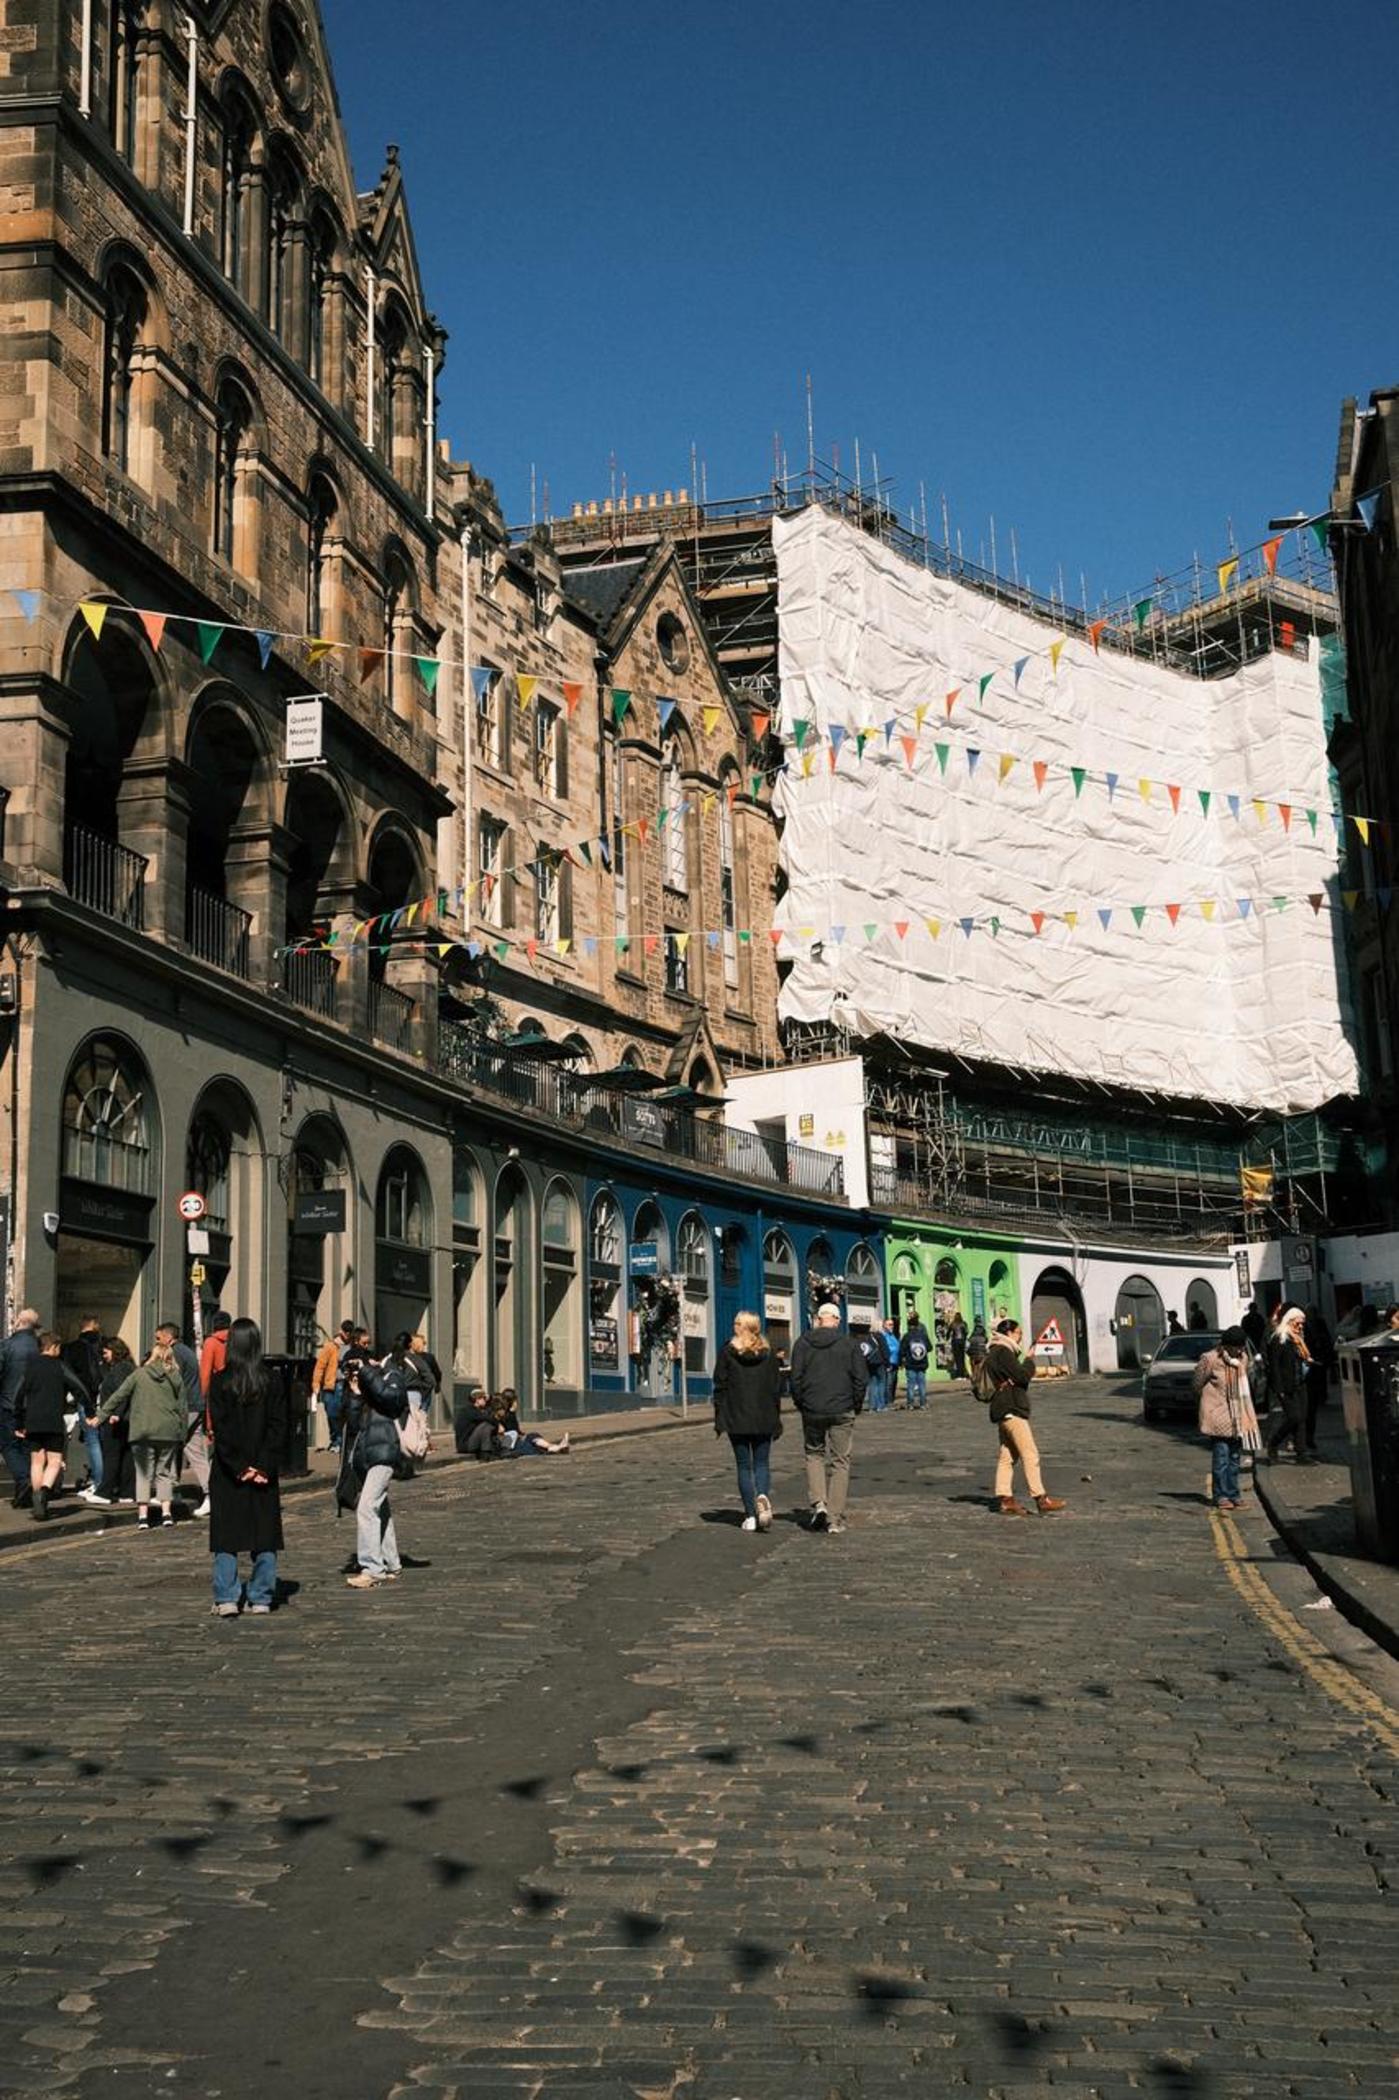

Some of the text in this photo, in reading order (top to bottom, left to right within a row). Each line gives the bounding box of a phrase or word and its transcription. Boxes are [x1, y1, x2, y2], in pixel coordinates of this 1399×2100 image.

[290, 715, 316, 724] Quaker
[289, 728, 317, 736] Meeting
[291, 739, 315, 747] House
